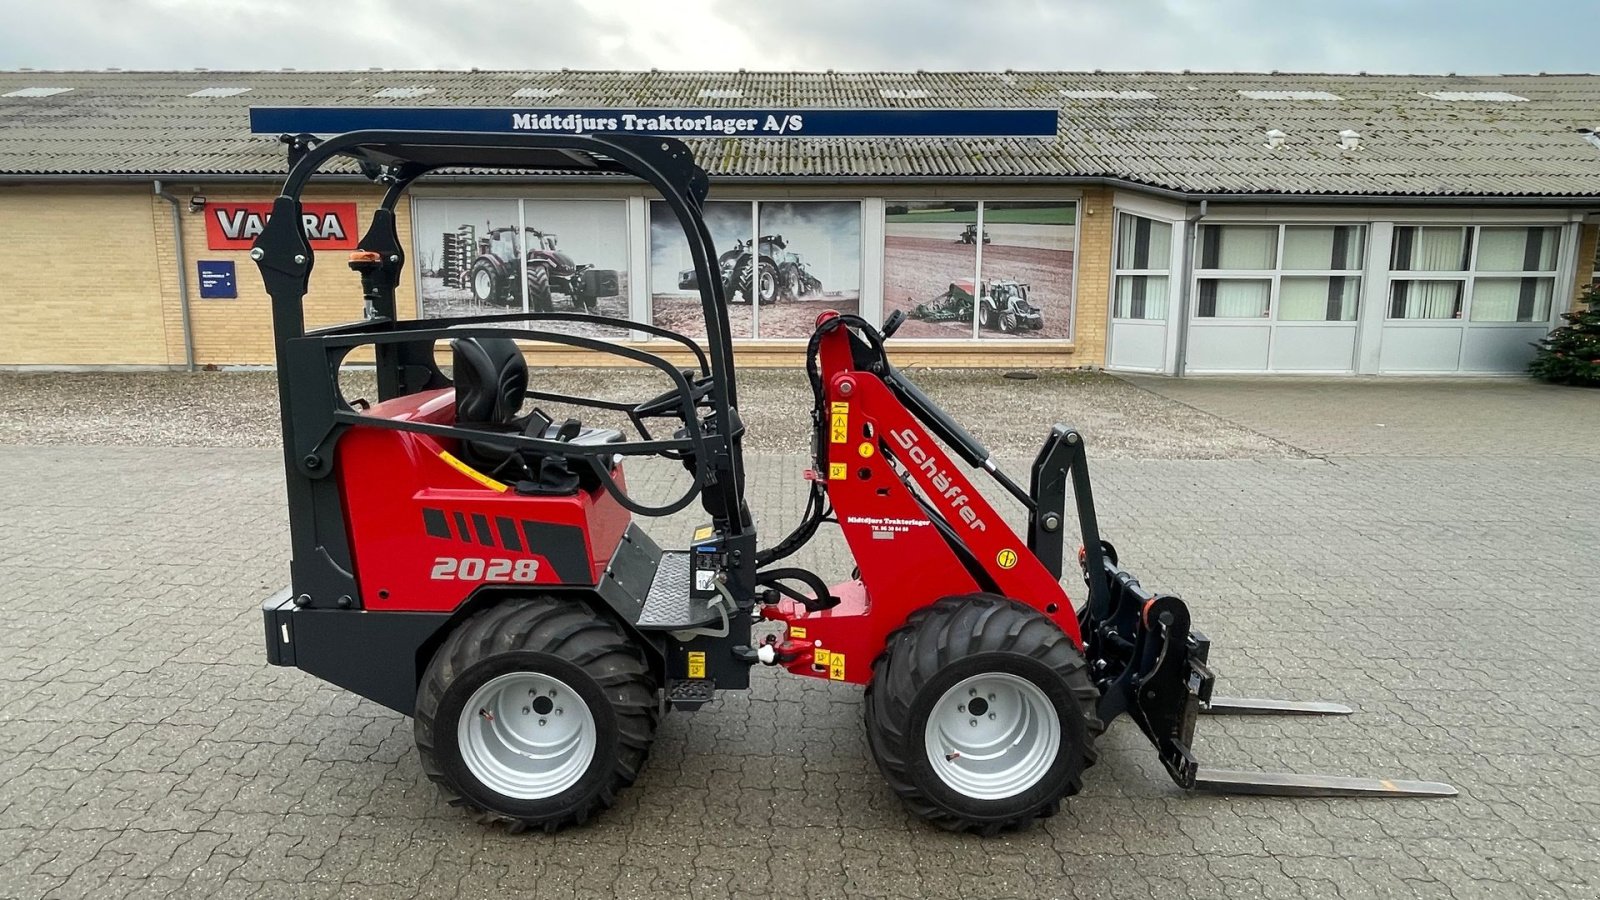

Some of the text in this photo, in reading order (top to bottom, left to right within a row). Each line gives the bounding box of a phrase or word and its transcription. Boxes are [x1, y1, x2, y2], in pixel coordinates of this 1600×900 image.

[512, 113, 803, 134] Midtdjurs Traktorlager A/S
[214, 208, 347, 240] VARA
[890, 428, 986, 532] Schäffer
[847, 516, 883, 525] Midtdjurs
[430, 557, 540, 582] 2028
